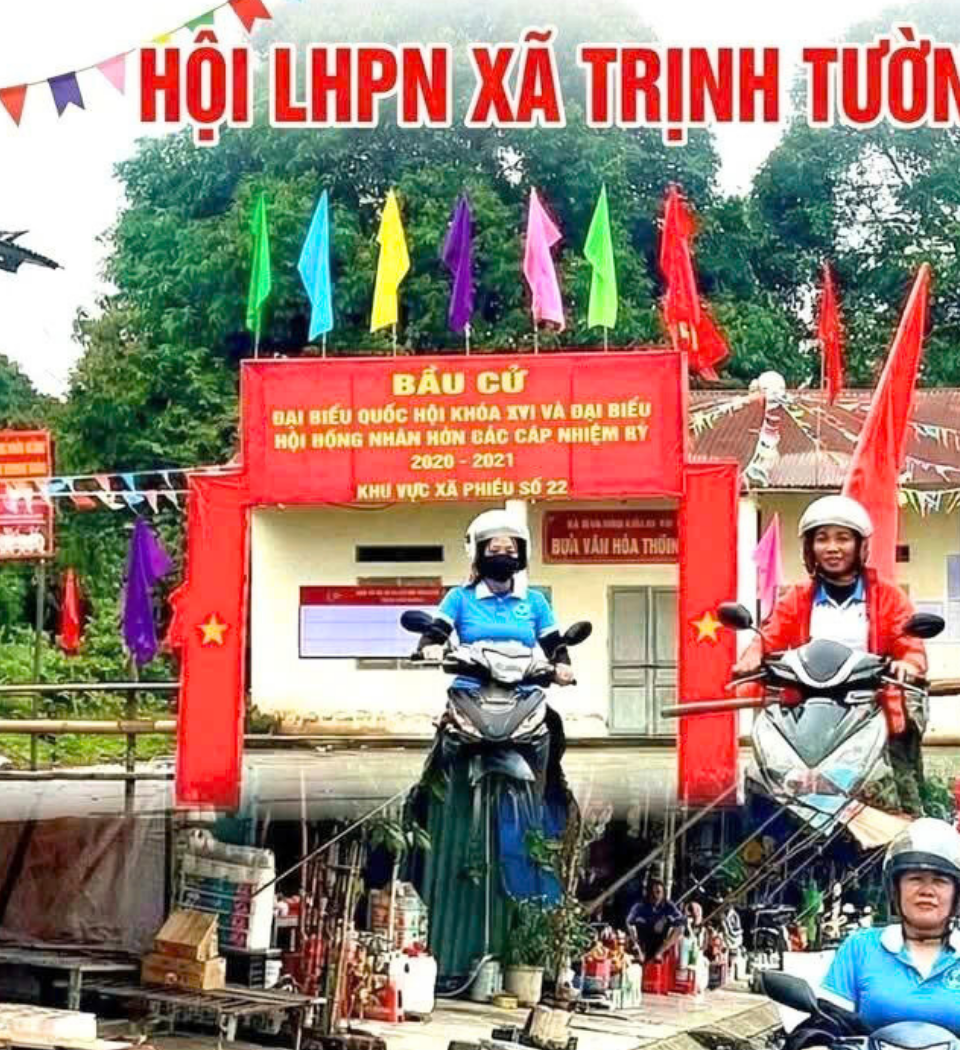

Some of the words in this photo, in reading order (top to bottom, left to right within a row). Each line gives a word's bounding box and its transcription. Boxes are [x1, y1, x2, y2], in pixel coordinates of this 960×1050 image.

[410, 453, 455, 470] 2020
[472, 452, 515, 468] 2021
[357, 483, 392, 499] KHU
[546, 480, 568, 495] 22
